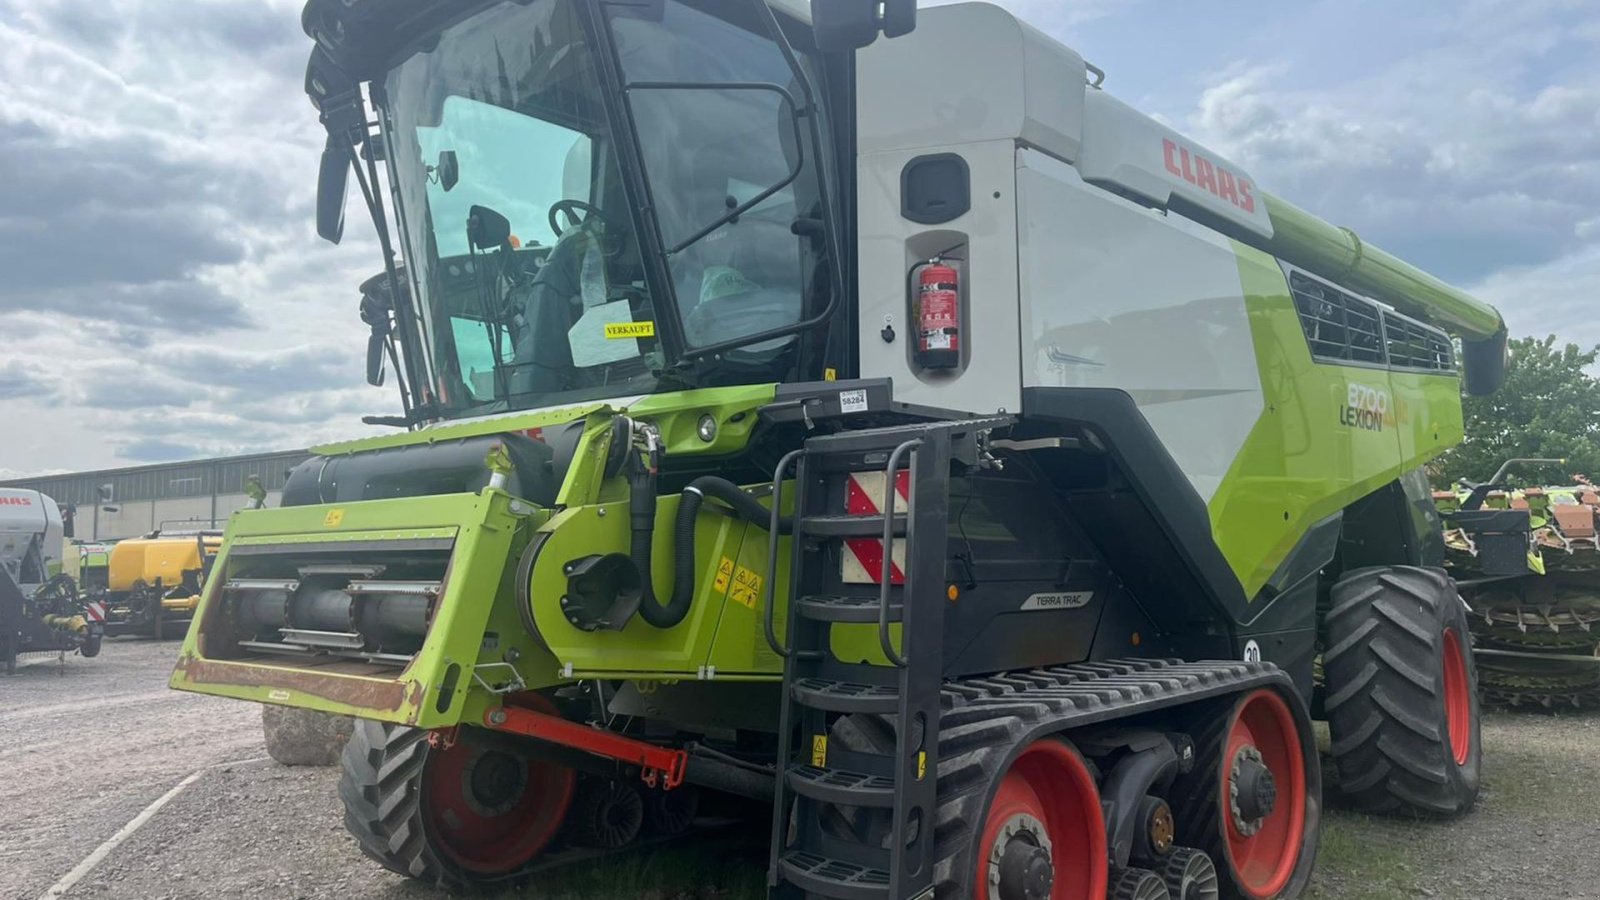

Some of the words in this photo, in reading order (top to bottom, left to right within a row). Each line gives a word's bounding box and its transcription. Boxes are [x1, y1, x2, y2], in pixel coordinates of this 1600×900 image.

[1162, 136, 1255, 213] CLAAS
[606, 325, 651, 335] VERKAUFT
[1348, 383, 1387, 413] 8700
[1340, 404, 1383, 433] LEXION
[1037, 596, 1061, 606] TERRA
[1063, 595, 1082, 605] TRAC
[1247, 647, 1258, 662] 30
